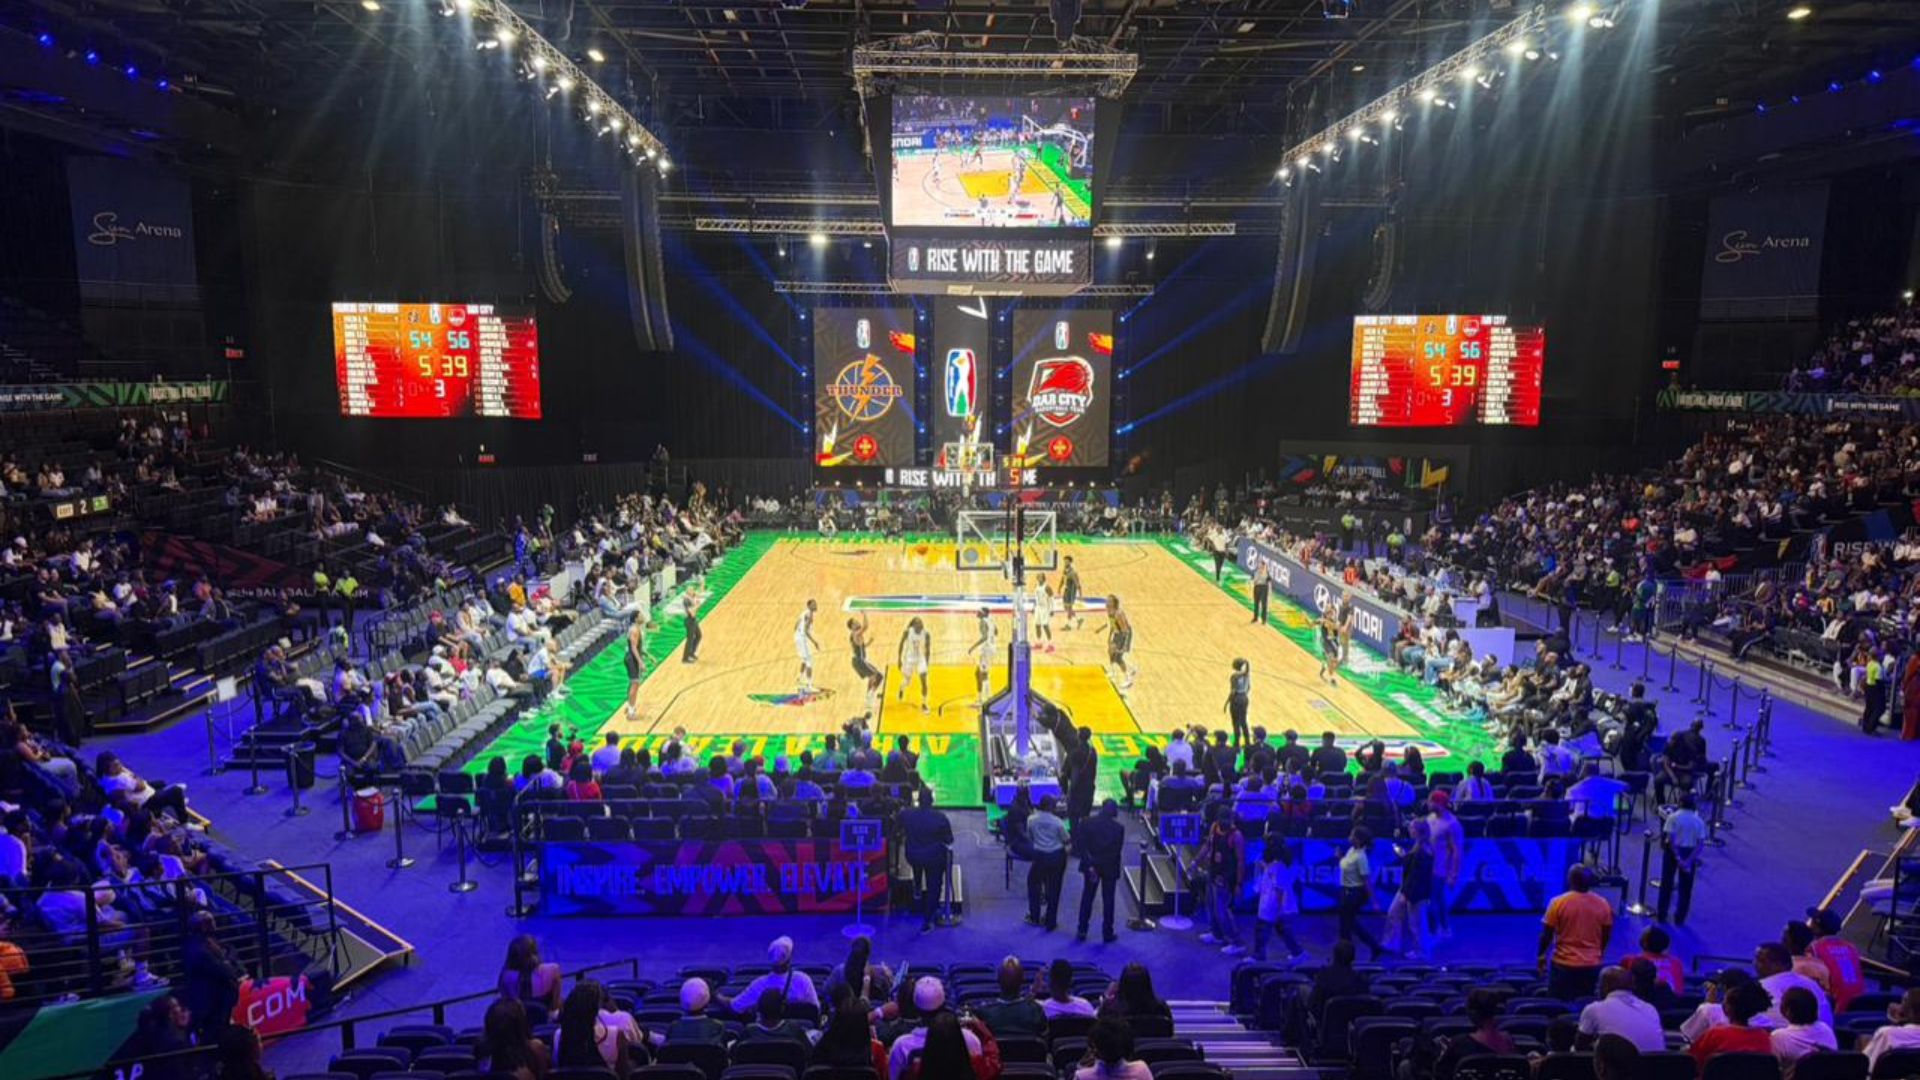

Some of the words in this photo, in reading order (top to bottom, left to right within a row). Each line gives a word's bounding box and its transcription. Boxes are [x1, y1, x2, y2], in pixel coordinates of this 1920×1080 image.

[136, 222, 181, 238] Arena
[1762, 235, 1809, 249] Arena
[927, 247, 957, 273] RISE
[962, 247, 1000, 273] WITH
[1005, 249, 1032, 273] THE
[1034, 249, 1073, 274] GAME
[409, 331, 433, 349] 54
[447, 331, 470, 349] 56
[1424, 341, 1446, 359] 54
[1460, 341, 1480, 359] 56
[434, 379, 446, 398] 3
[826, 384, 903, 397] THUNDER
[1032, 394, 1057, 408] DAR
[1059, 393, 1086, 408] CITY
[1441, 389, 1452, 407] 3
[900, 469, 928, 487] RISE
[1010, 468, 1020, 485] 5
[80, 499, 88, 515] 2
[653, 864, 771, 894] EMPOWER.
[779, 862, 869, 893] ELEVATE
[247, 976, 306, 1026] COM
